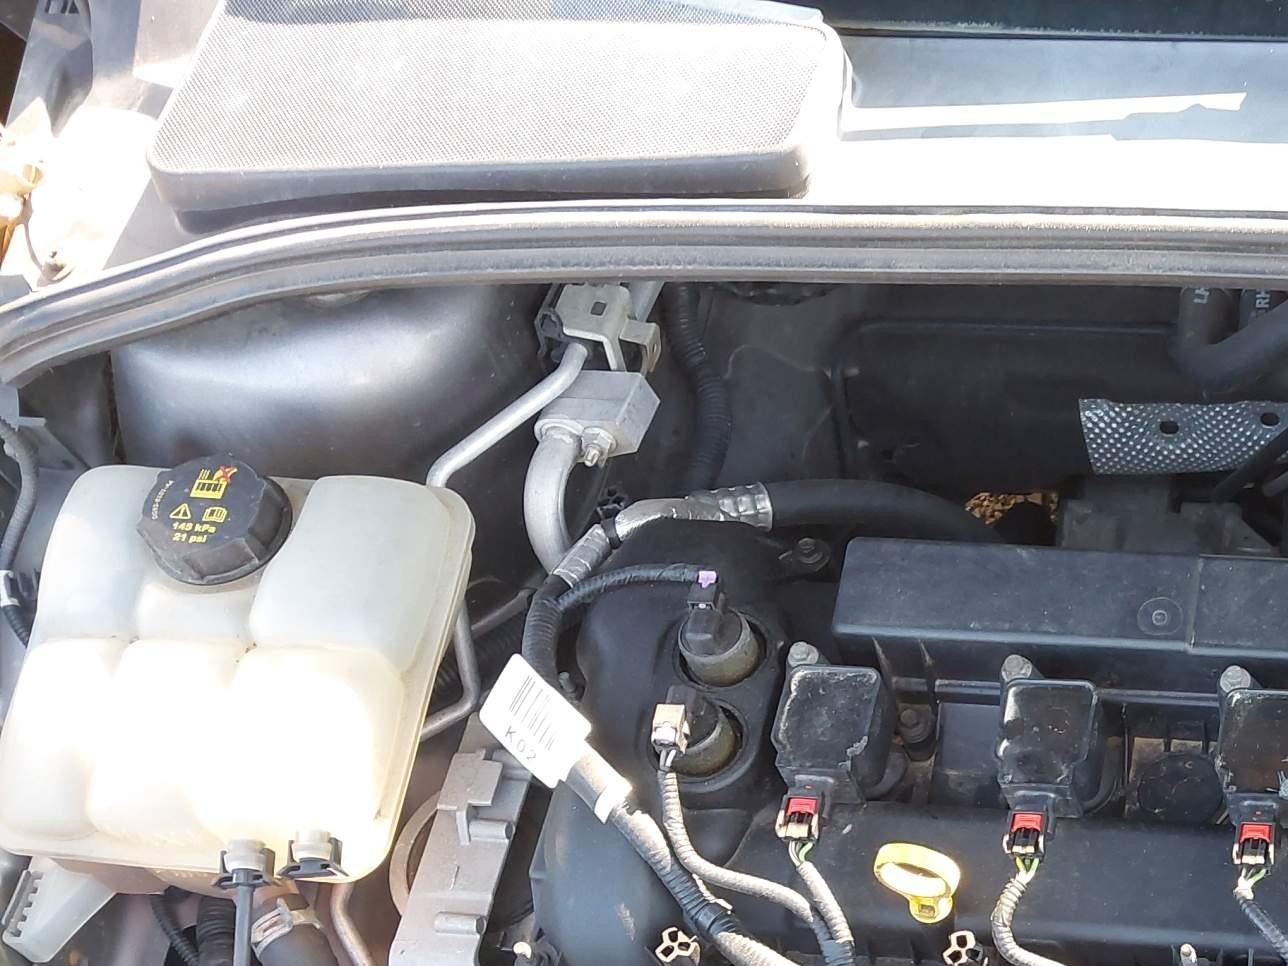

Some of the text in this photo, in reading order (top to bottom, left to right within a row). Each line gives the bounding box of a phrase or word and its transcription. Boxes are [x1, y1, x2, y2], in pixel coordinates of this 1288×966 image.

[194, 522, 217, 533] kPa
[172, 532, 208, 544] 21 psi
